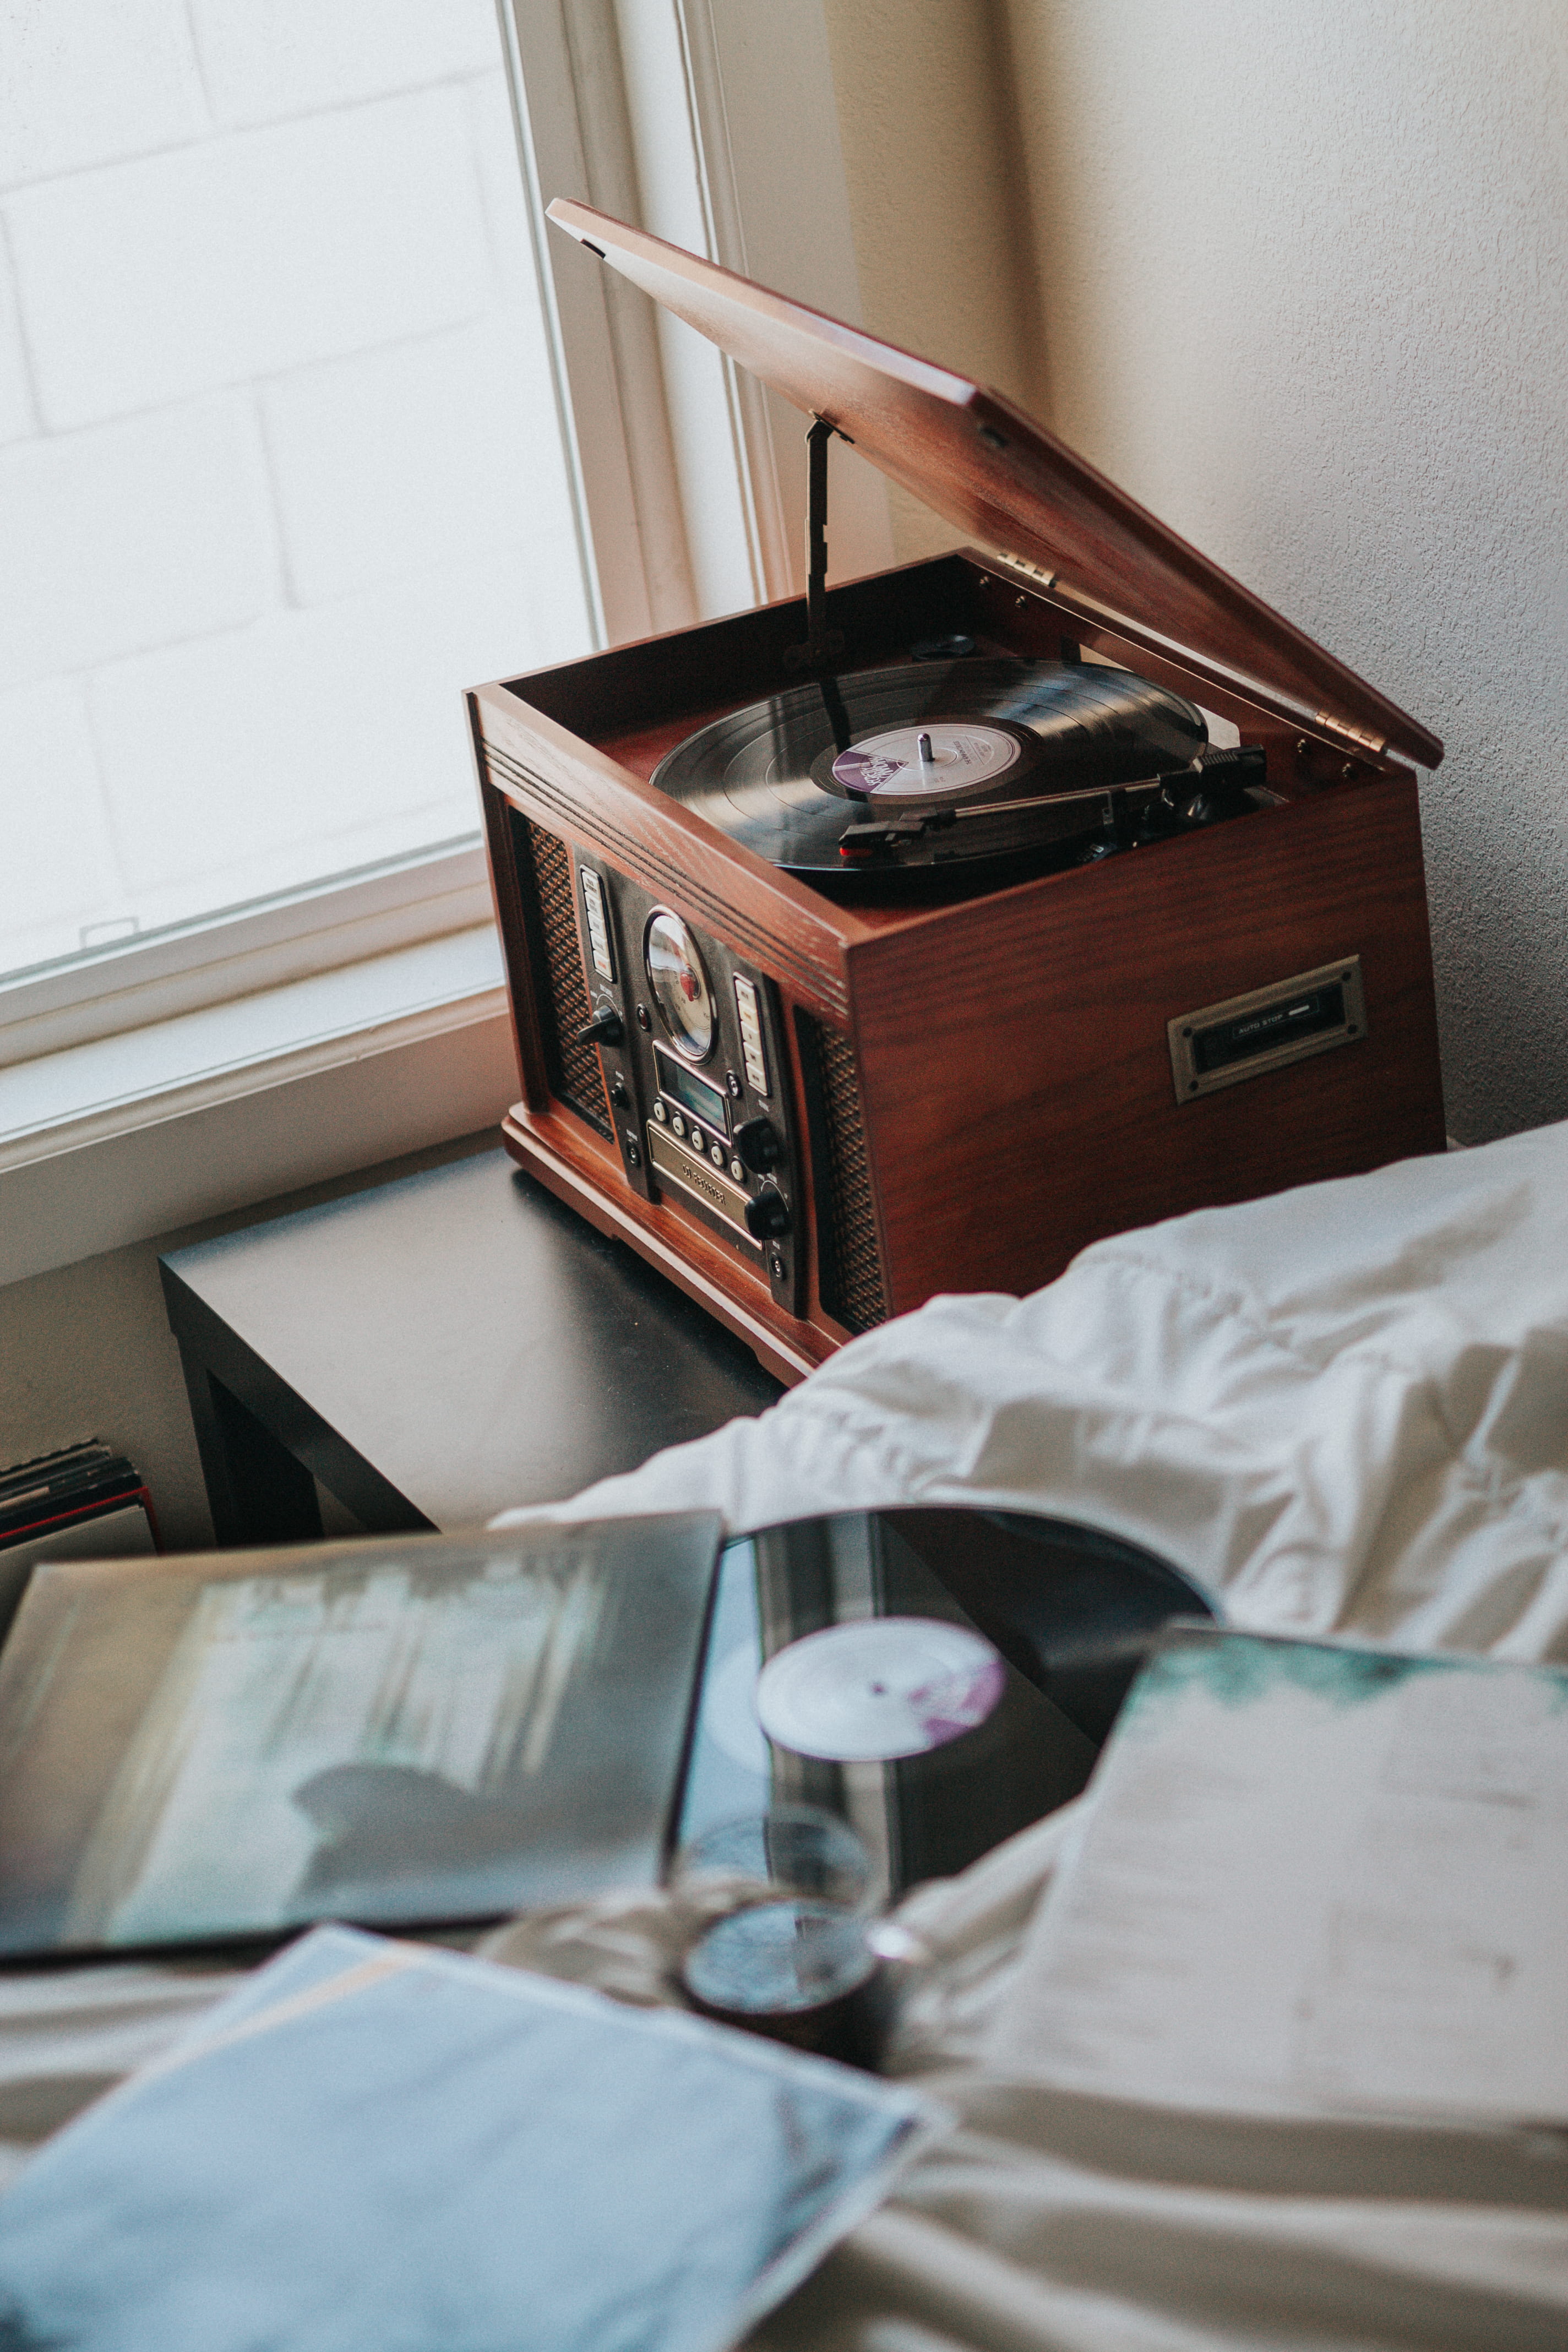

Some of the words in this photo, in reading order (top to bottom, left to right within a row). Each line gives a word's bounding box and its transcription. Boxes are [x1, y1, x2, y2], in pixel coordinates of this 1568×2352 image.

[868, 757, 895, 778] CANADIAN
[1238, 1022, 1260, 1033] AUTO
[1262, 1014, 1283, 1025] STOP
[683, 1164, 692, 1179] CD
[694, 1173, 726, 1205] RECORDER
